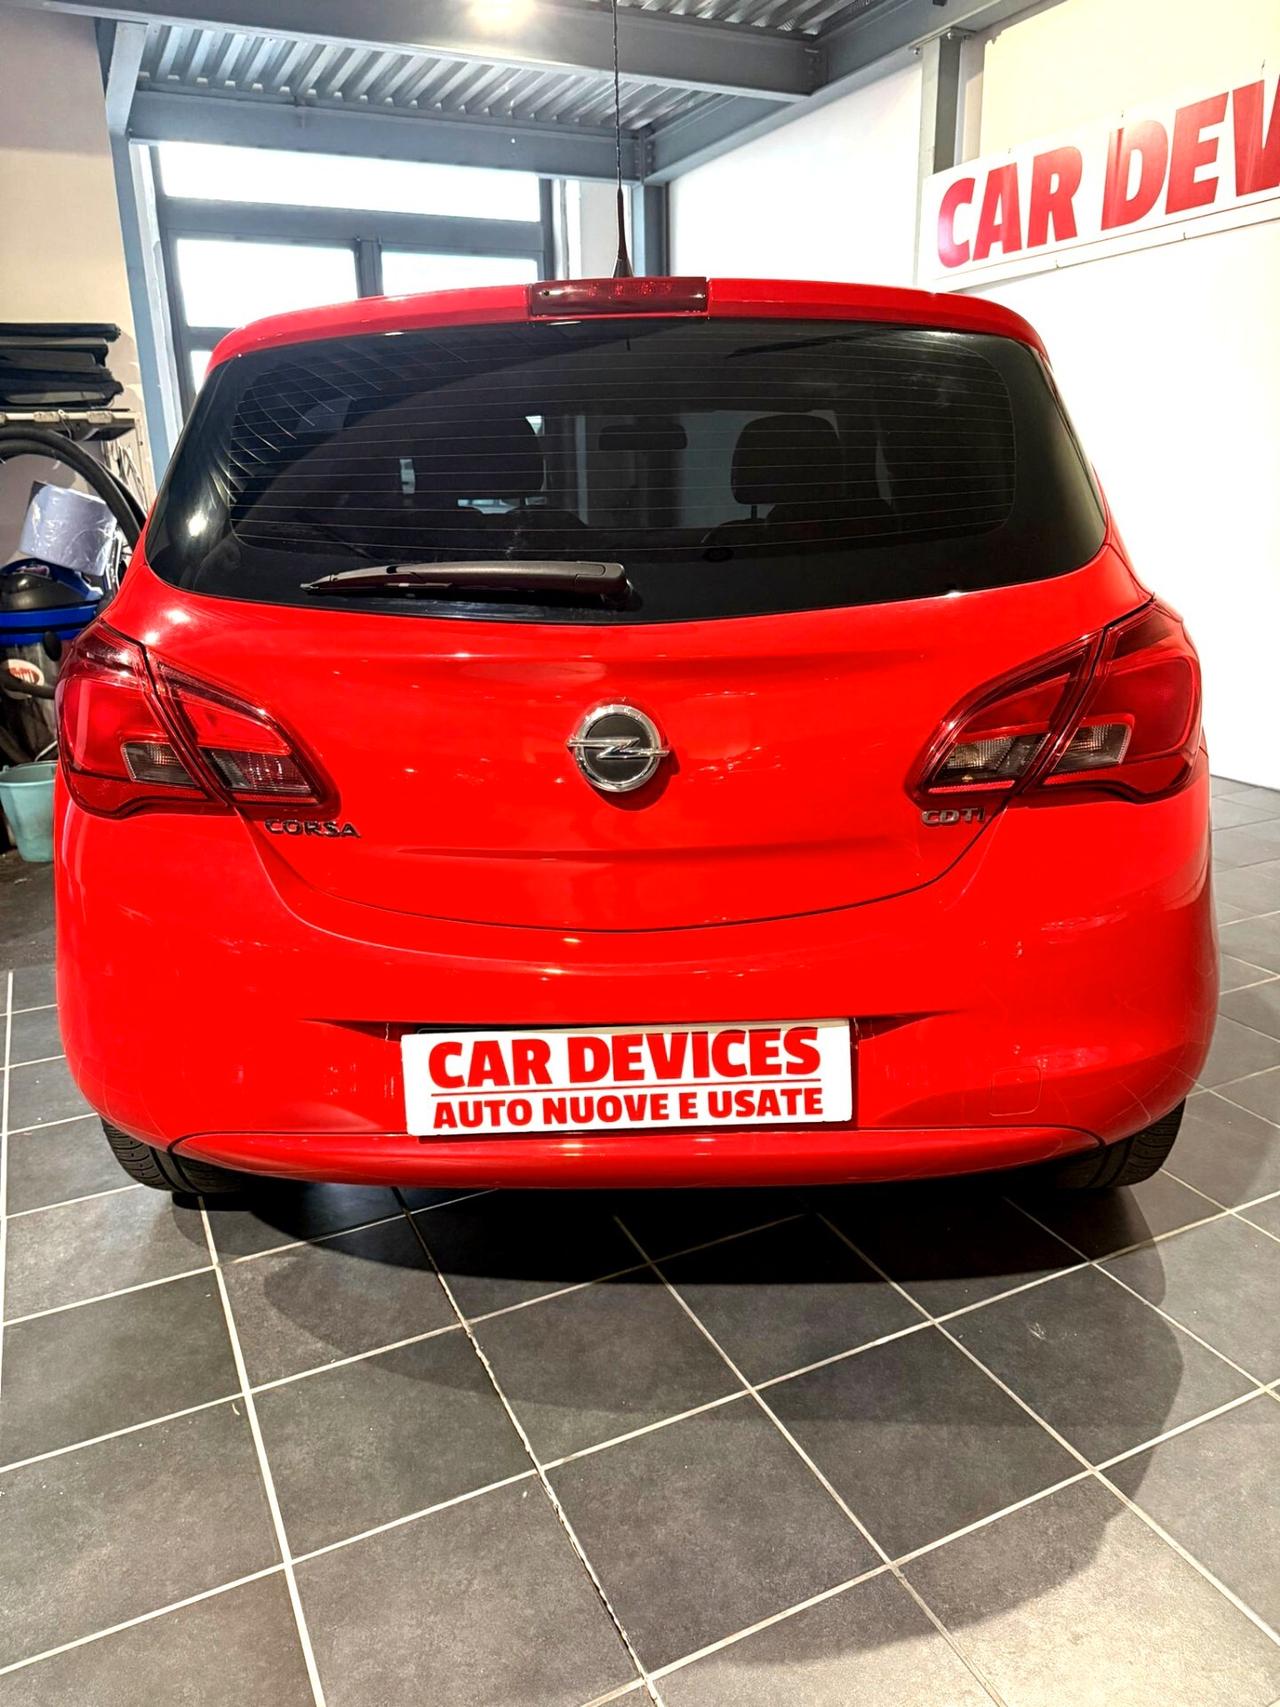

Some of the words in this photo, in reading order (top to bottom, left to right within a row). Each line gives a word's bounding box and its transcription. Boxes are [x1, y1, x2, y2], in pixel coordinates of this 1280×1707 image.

[938, 145, 1083, 269] CAR
[265, 818, 361, 838] CORSA
[921, 808, 986, 825] CDTI
[428, 1037, 552, 1089] CAR
[567, 1026, 822, 1084] DEVICES
[433, 1097, 532, 1129] AUTO
[543, 1093, 670, 1125] NUOVE
[678, 1092, 698, 1119] E
[707, 1087, 823, 1118] USATE
